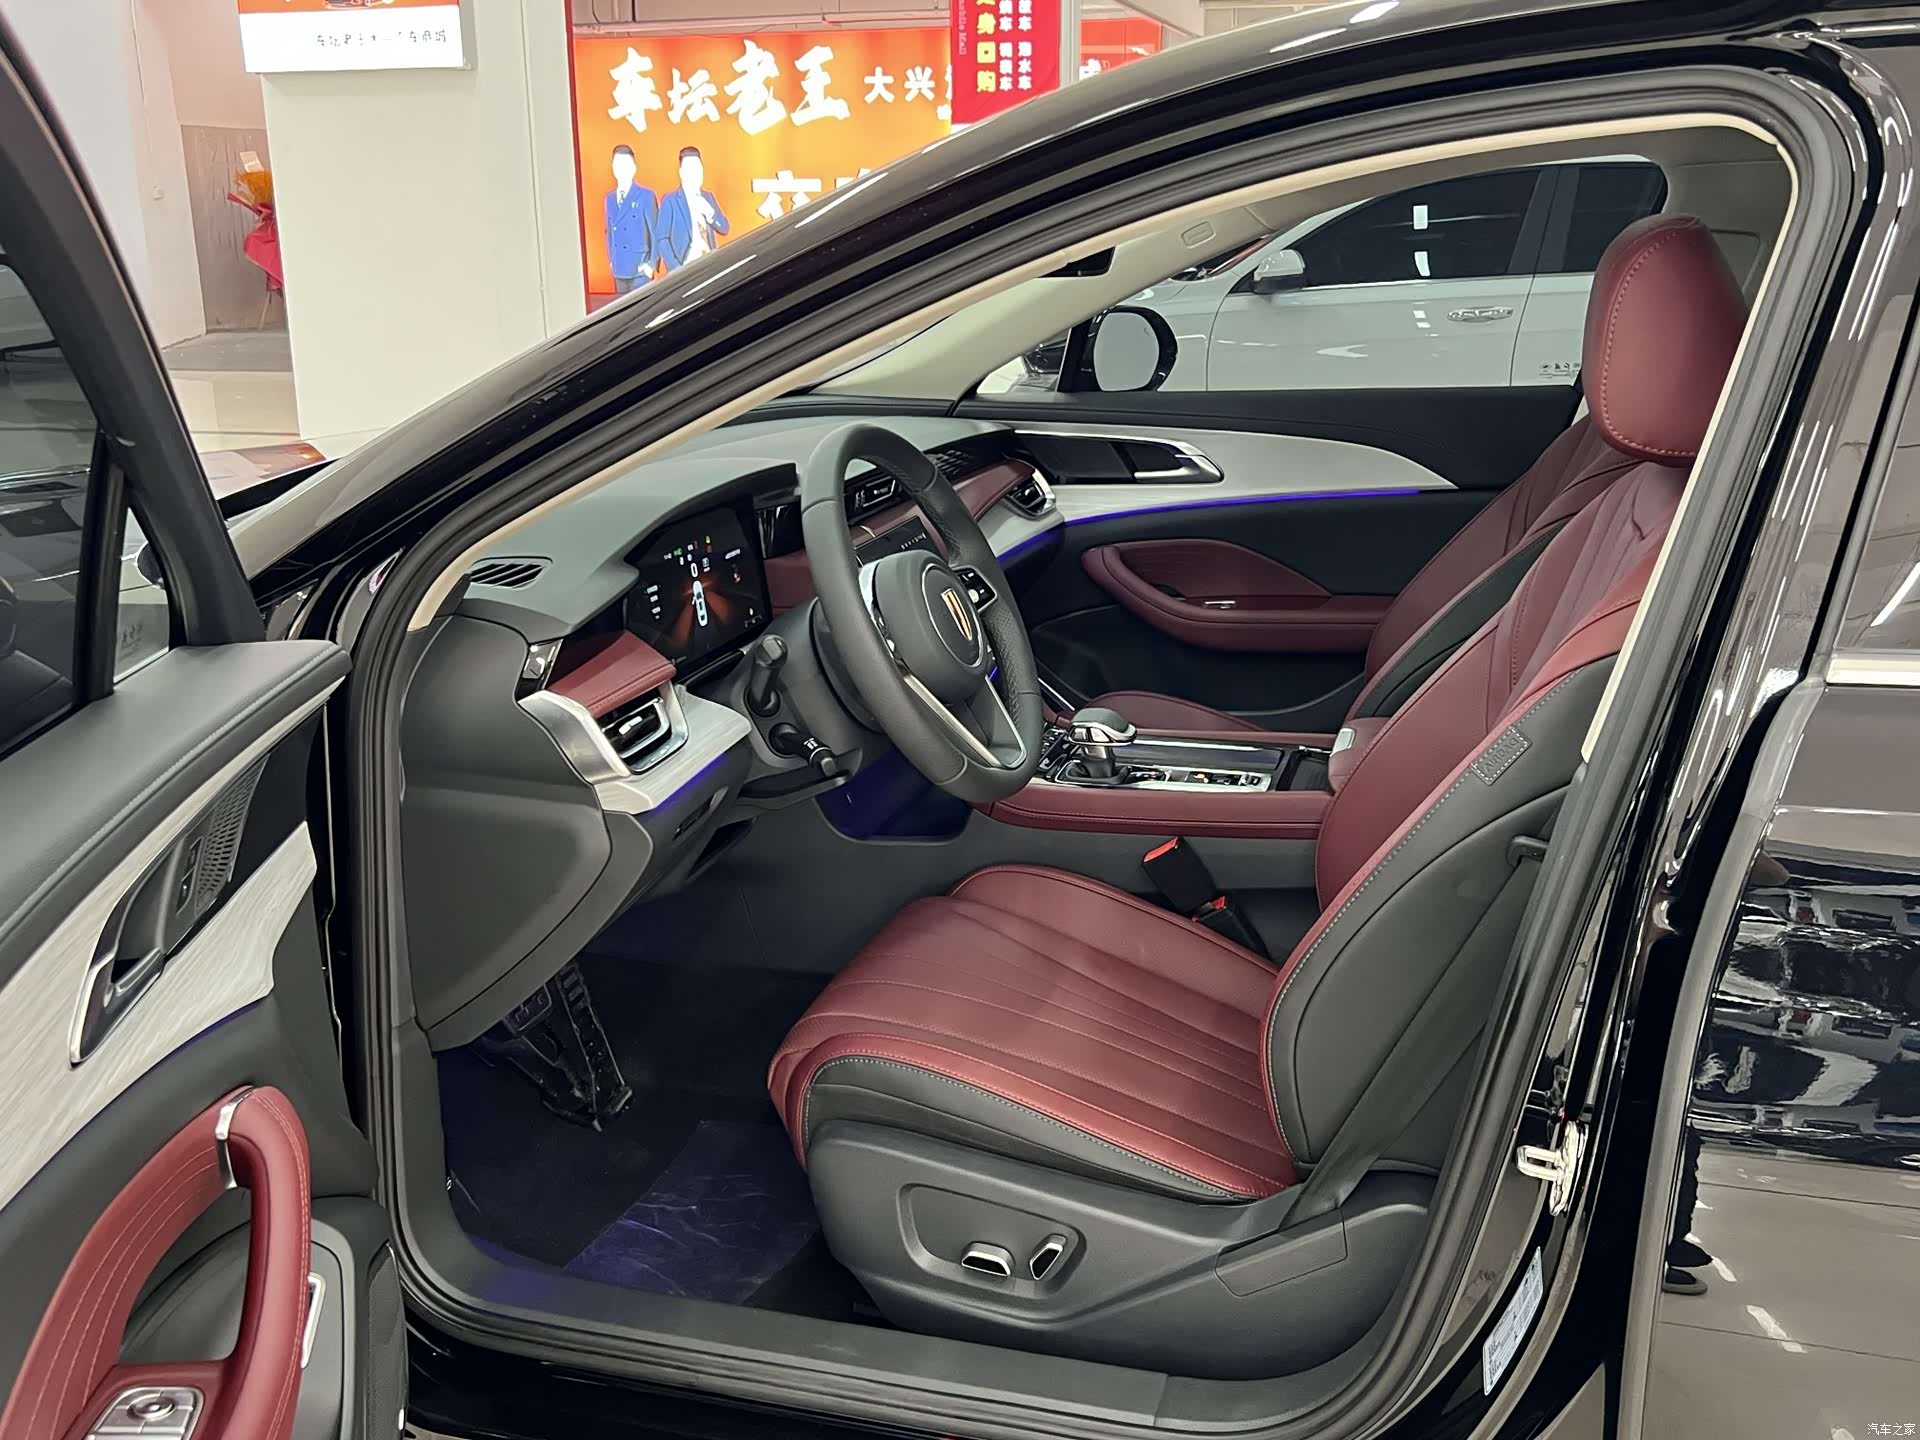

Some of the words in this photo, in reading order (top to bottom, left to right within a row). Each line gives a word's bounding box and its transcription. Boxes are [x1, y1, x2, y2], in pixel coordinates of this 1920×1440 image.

[608, 39, 851, 136] 车坛老王
[863, 66, 952, 105] 大兴
[977, 0, 996, 92] 身回购
